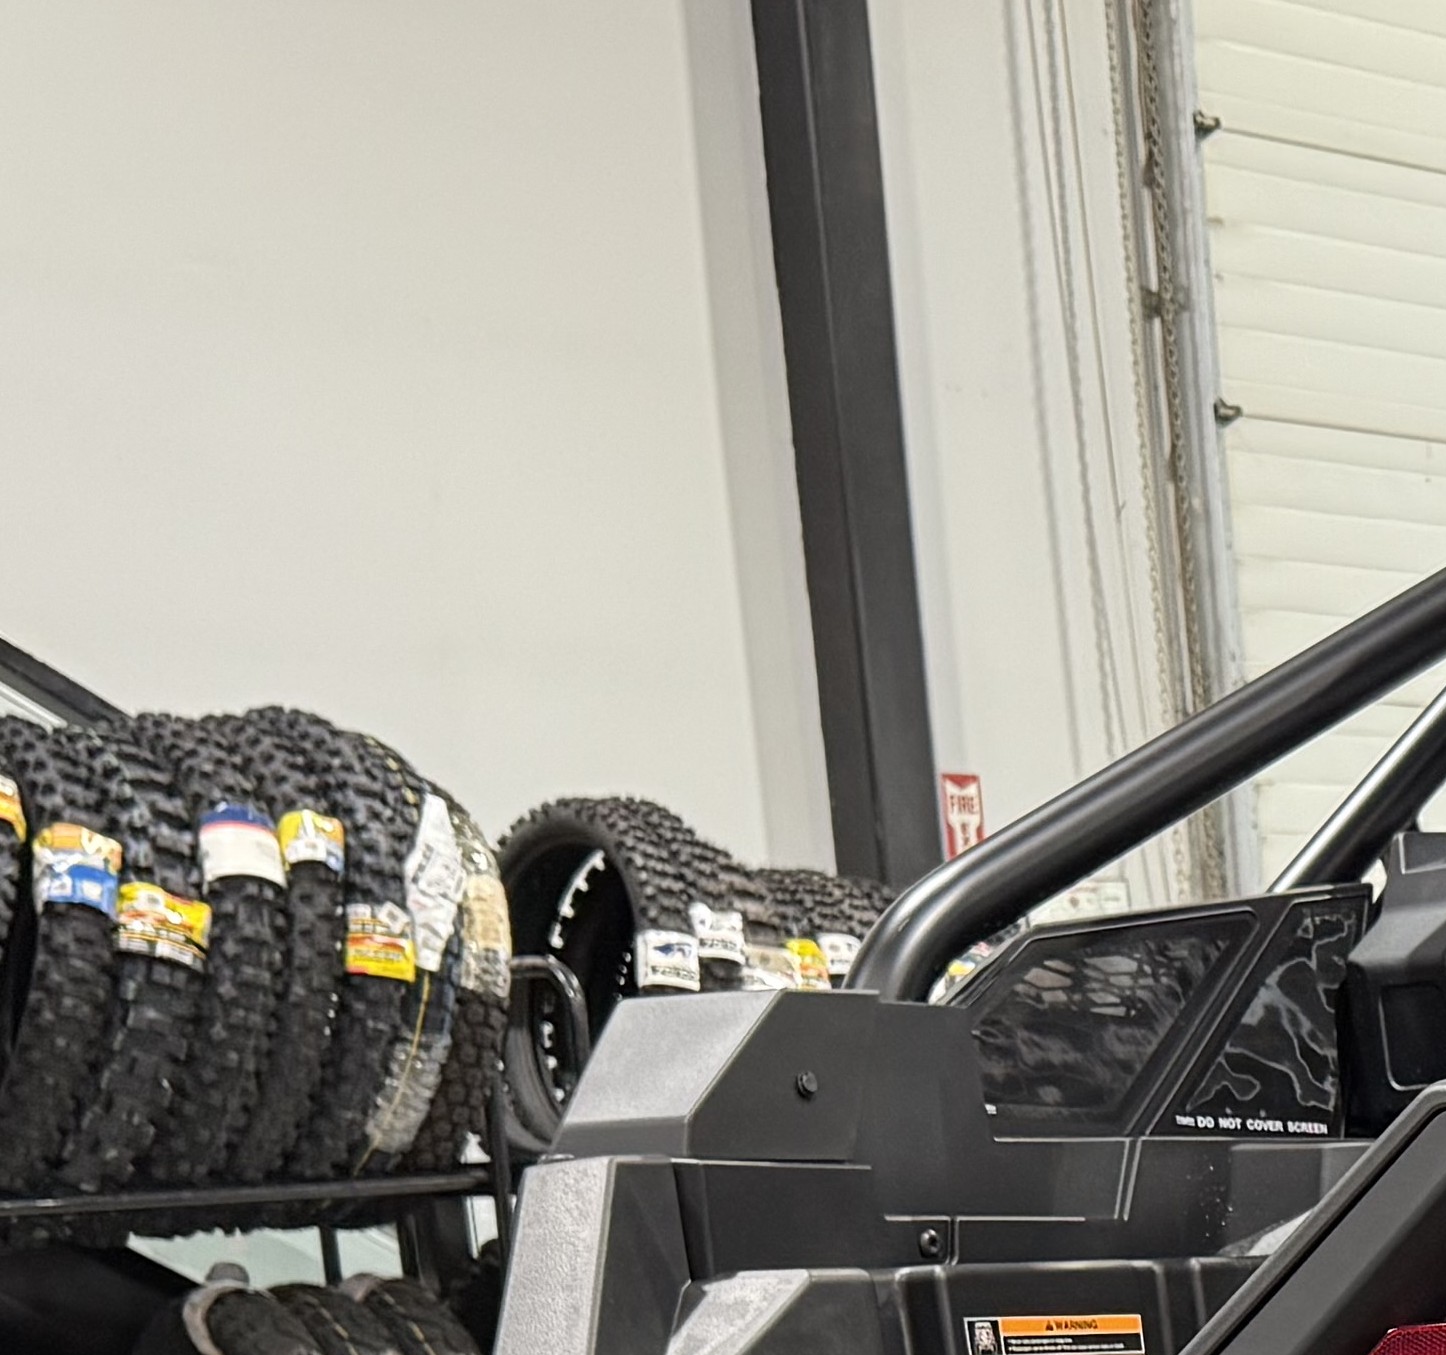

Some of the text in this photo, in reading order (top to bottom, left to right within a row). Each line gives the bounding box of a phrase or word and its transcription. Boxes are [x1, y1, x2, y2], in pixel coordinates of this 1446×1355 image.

[1196, 1116, 1215, 1128] DO
[1218, 1117, 1242, 1130] NOT
[1246, 1119, 1284, 1132] COVER
[1287, 1120, 1329, 1135] SCREEN
[1055, 1319, 1098, 1330] WARNING
